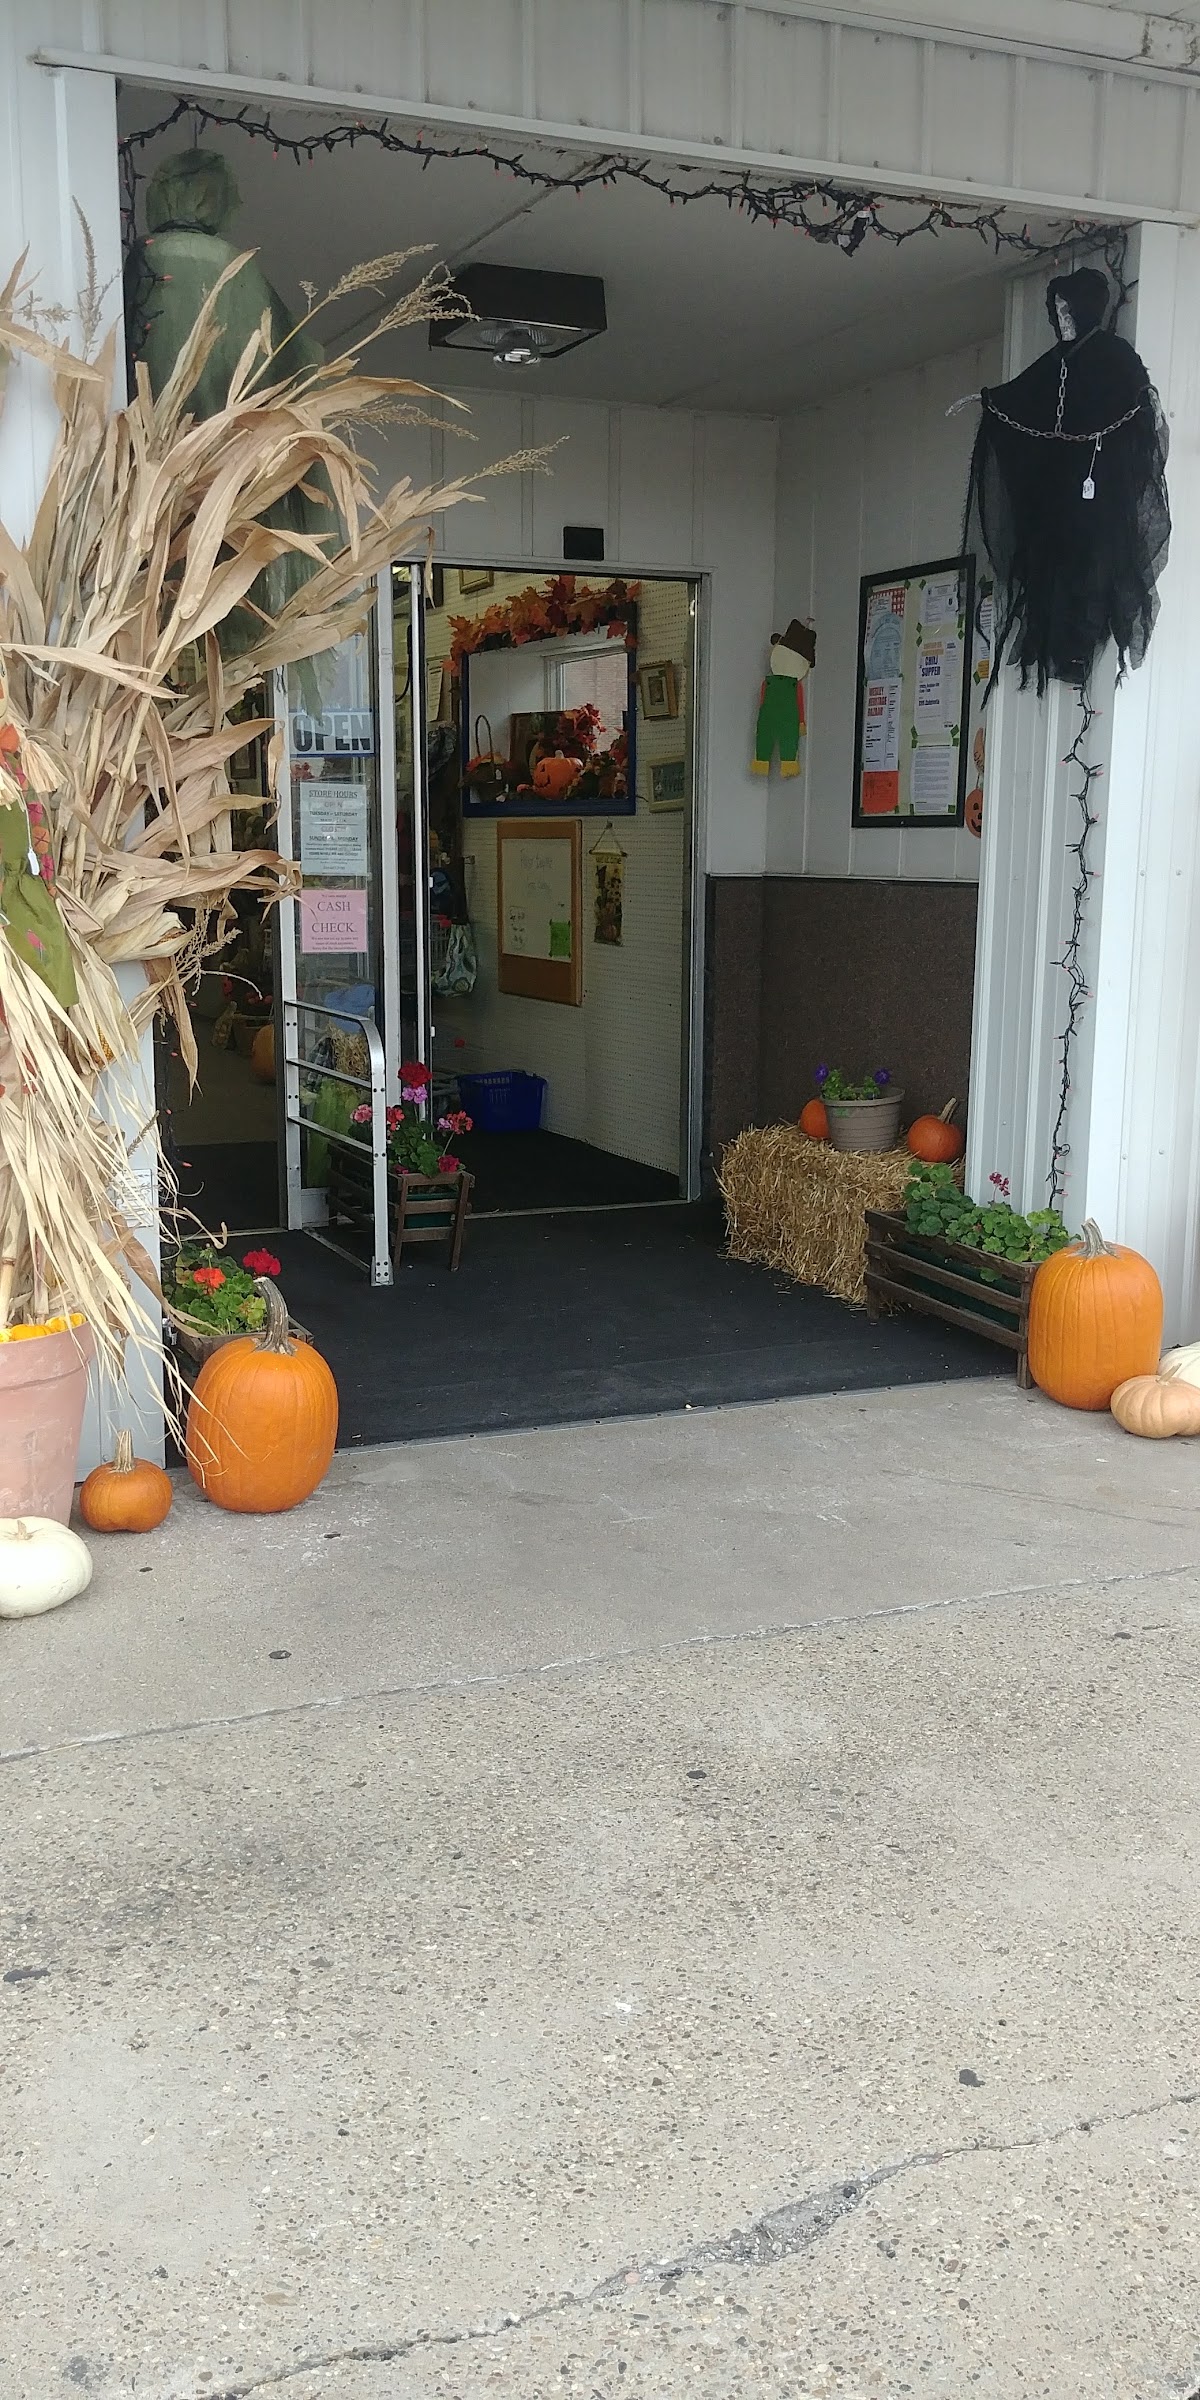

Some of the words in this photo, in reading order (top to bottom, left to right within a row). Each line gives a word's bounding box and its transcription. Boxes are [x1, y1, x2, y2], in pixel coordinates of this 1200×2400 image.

[293, 715, 371, 751] OPEN
[309, 790, 331, 798] STORE
[333, 790, 358, 798] HOURS
[317, 901, 351, 911] CASH
